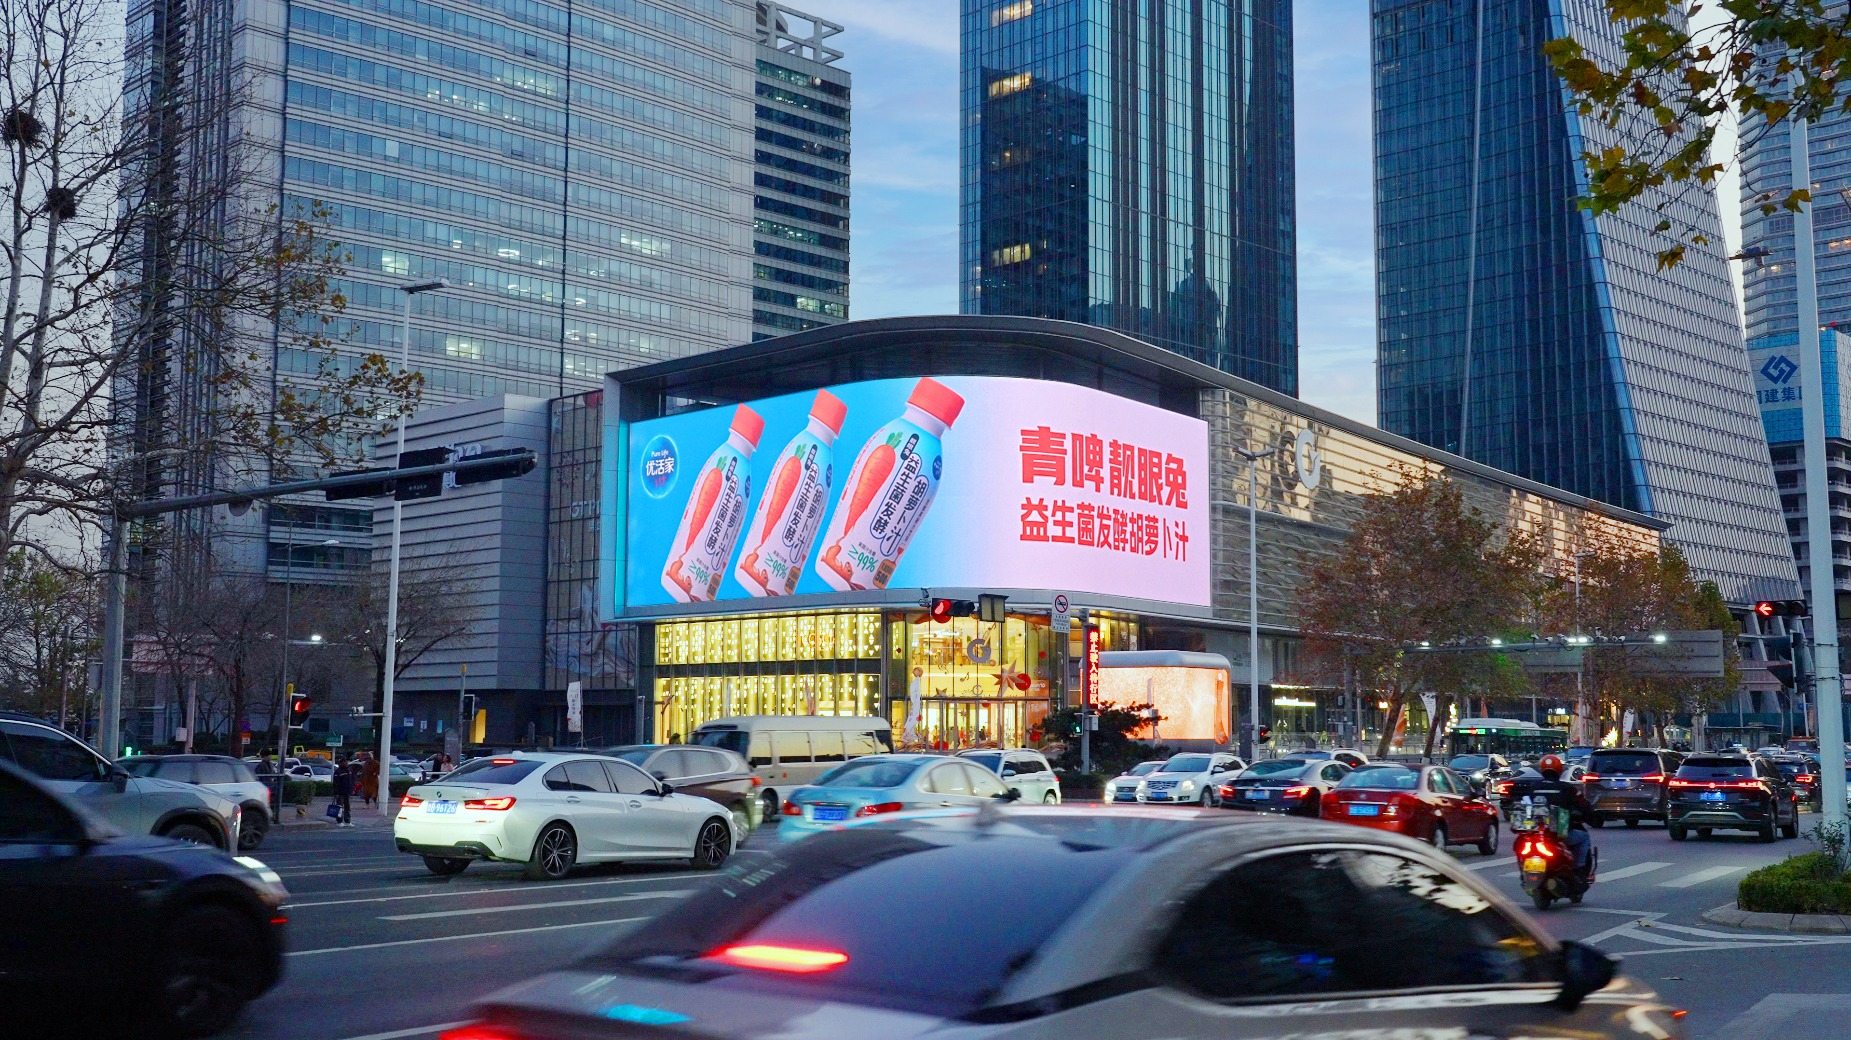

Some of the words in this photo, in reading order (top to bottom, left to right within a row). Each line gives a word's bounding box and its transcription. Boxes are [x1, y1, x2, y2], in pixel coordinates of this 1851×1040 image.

[646, 457, 675, 476] 优活家
[785, 465, 818, 542] 益生菌发酵
[873, 455, 920, 535] 益生菌发酵
[1019, 425, 1189, 510] 青啤靓眼兔
[793, 489, 823, 561] 胡萝卜汁
[886, 479, 928, 554] 胡萝卜汁
[1019, 496, 1189, 562] 益生菌发酵胡萝卜汁
